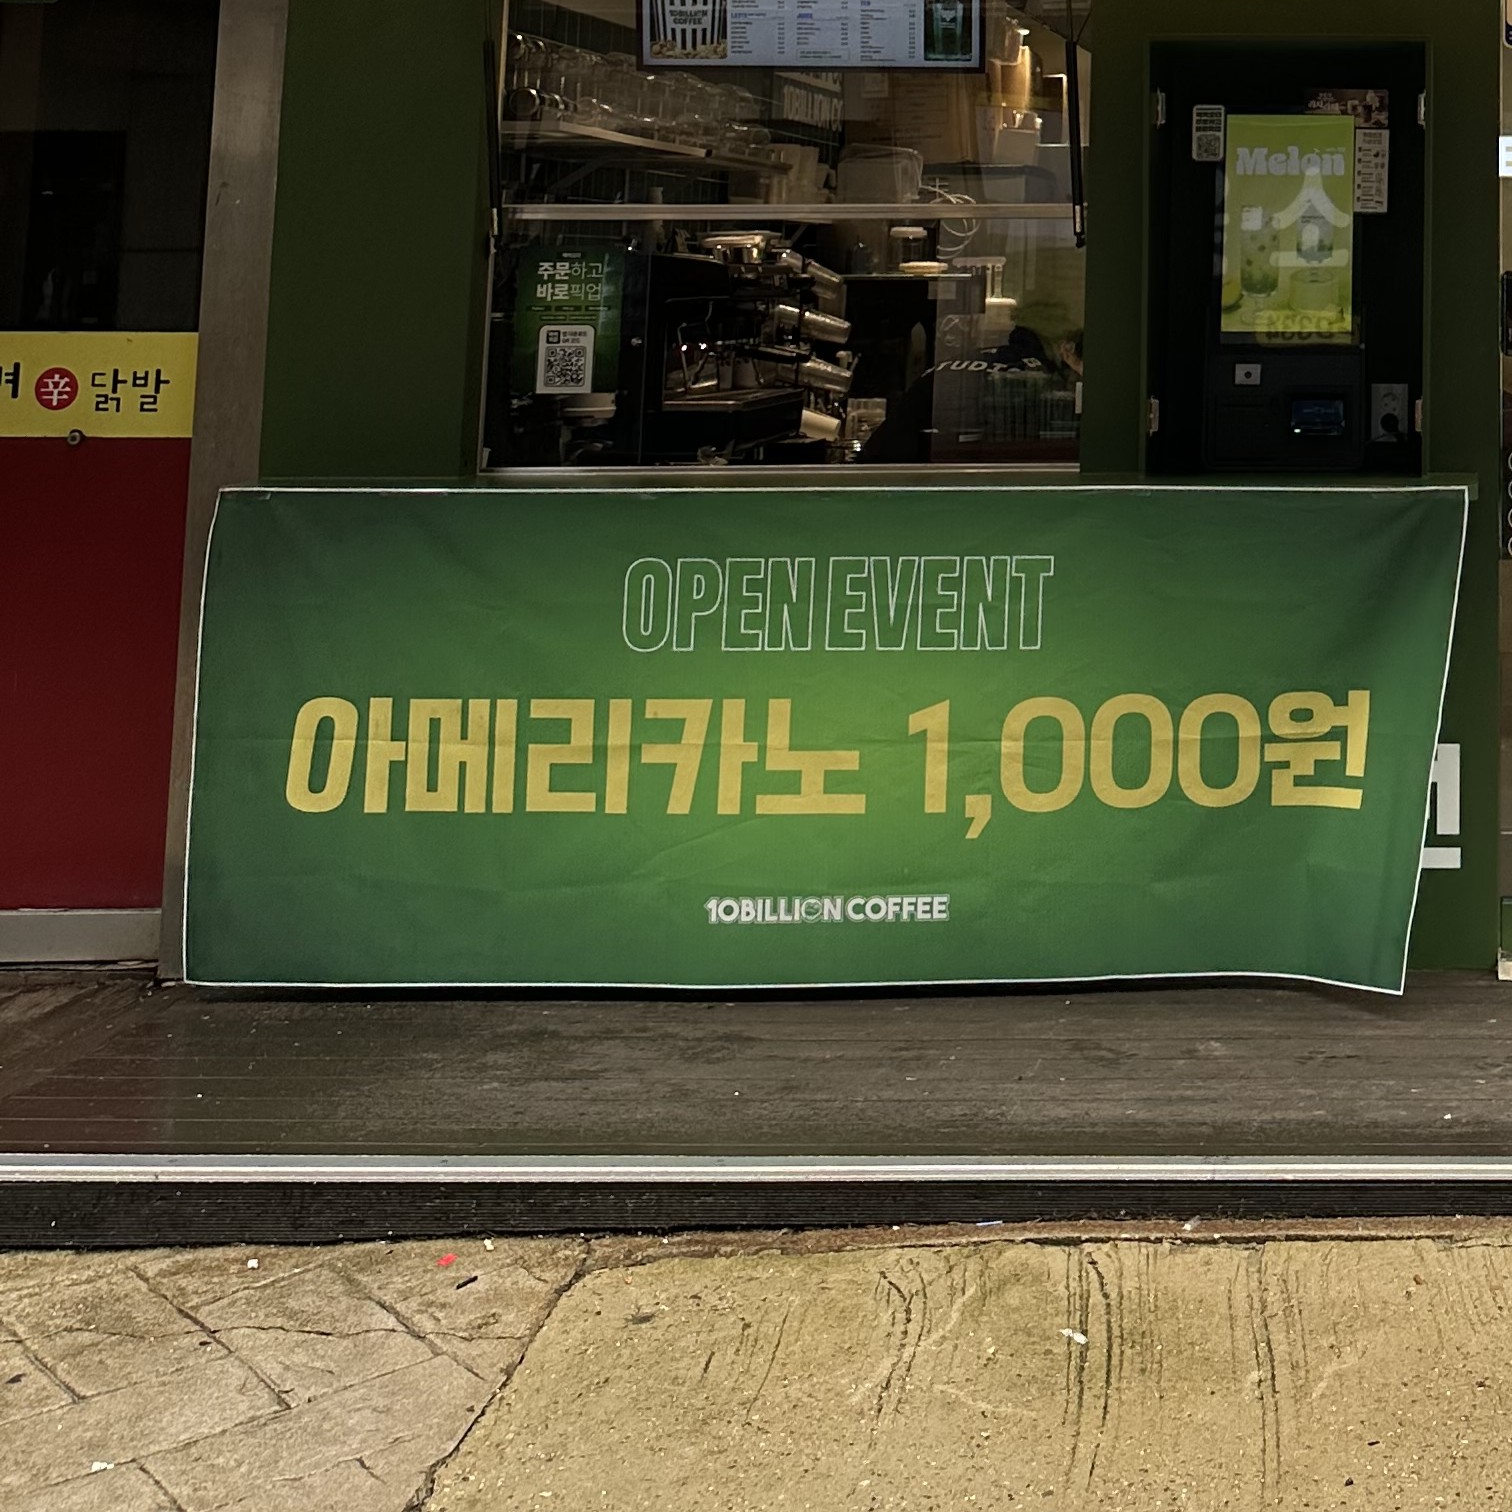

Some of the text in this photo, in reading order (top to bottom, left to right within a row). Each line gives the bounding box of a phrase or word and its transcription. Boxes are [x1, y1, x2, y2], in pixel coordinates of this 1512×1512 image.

[1235, 146, 1345, 176] Melon
[537, 261, 604, 281] 주문하고
[40, 373, 72, 407] 辛
[91, 368, 171, 413] 닭발
[622, 555, 1055, 653] OPEN EVENT
[285, 695, 867, 815] 아메리카노
[908, 689, 1371, 840] 1,000원
[704, 894, 950, 924] 10BILLION COFFEE
